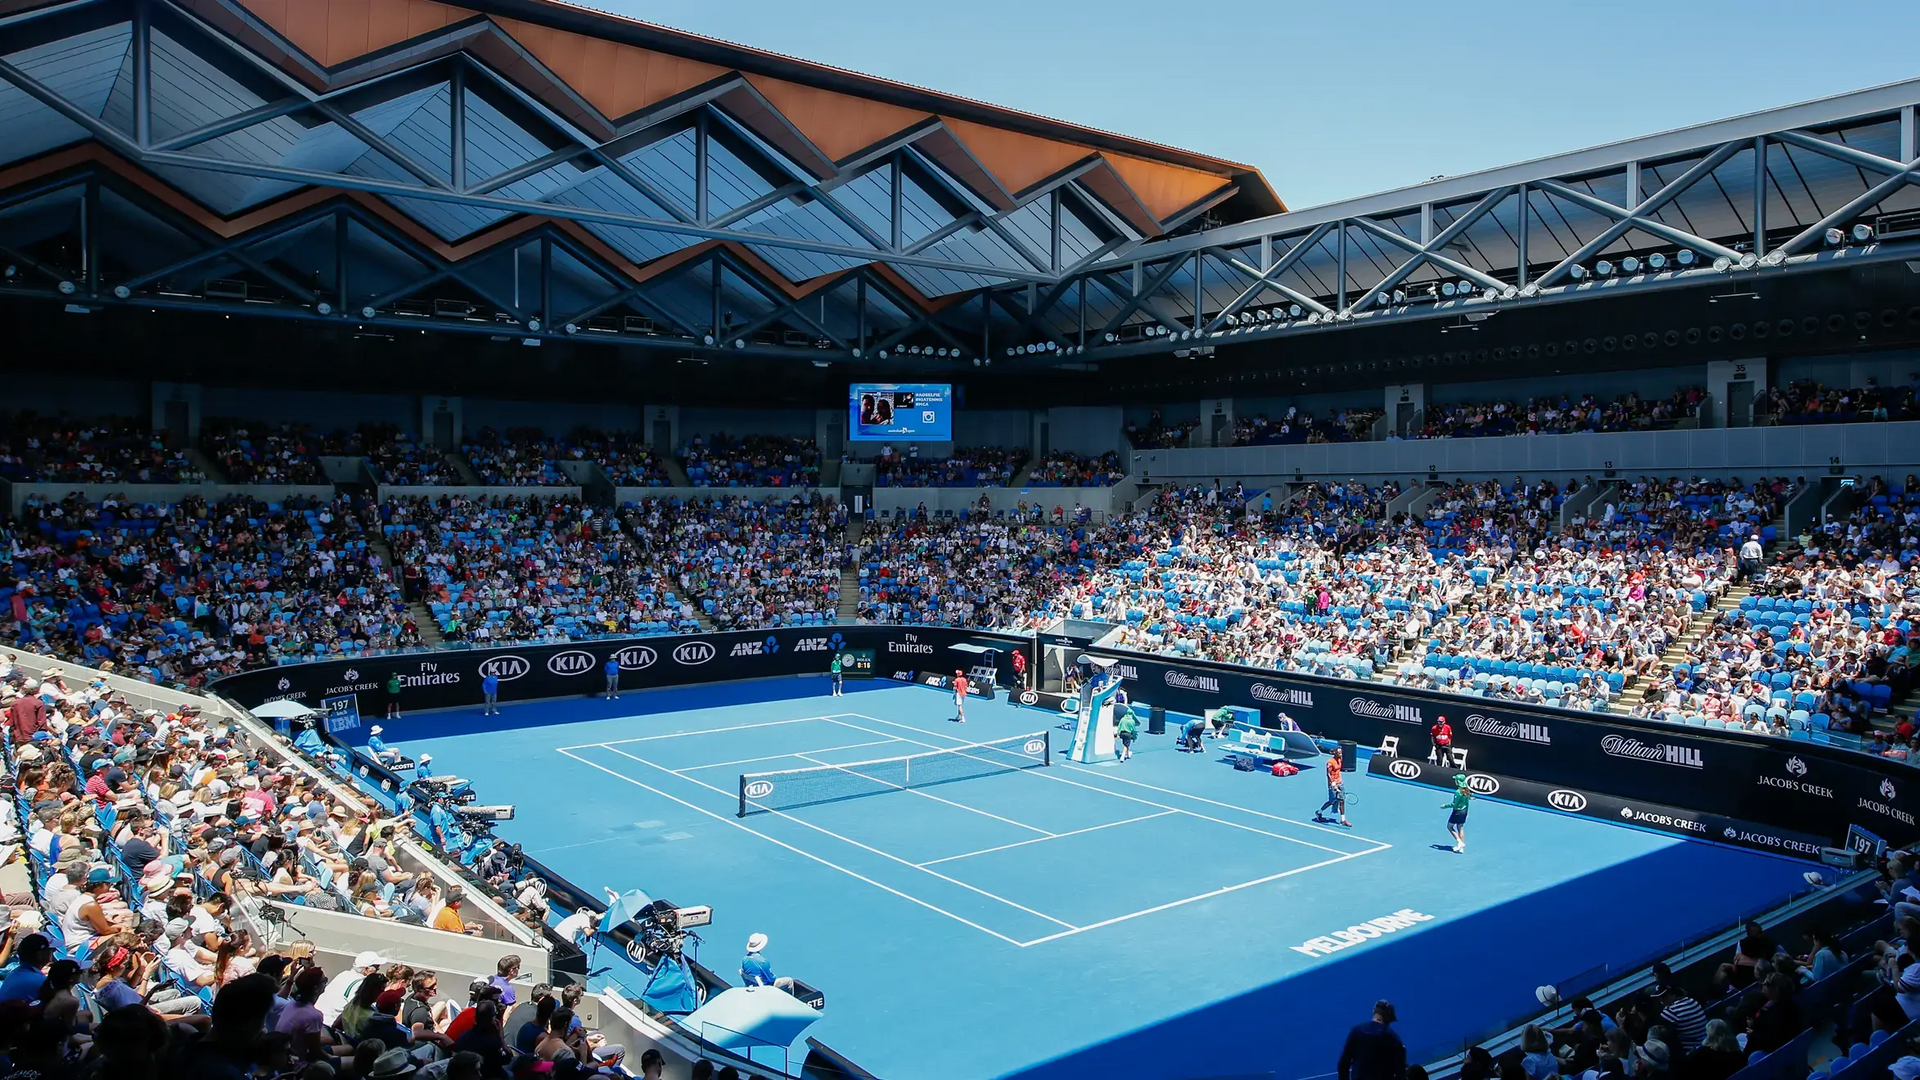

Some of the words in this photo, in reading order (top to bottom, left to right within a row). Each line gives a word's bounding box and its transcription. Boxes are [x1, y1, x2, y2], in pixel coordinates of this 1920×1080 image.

[1735, 364, 1745, 372] 35
[1829, 456, 1840, 464] 14
[794, 638, 828, 652] ANZ
[905, 633, 918, 643] Fly
[680, 646, 709, 661] KIA
[730, 641, 763, 657] ANZ
[888, 641, 934, 654] Emirates
[555, 655, 588, 671] KIA
[619, 650, 651, 666] KIA
[420, 662, 438, 673] Fly
[487, 660, 522, 676] KIA
[1120, 664, 1138, 679] HILL
[397, 672, 460, 688] Emirates
[925, 676, 941, 687] ANZ
[1164, 669, 1200, 689] William
[1199, 676, 1219, 691] HILL
[286, 691, 307, 700] CREEK
[325, 684, 354, 695] JACOB'S
[354, 682, 379, 692] CREEK
[1250, 682, 1290, 703] William
[1290, 689, 1314, 706] HILL
[331, 699, 350, 711] 197
[1022, 693, 1035, 703] KIA
[1349, 697, 1396, 718] William
[1395, 704, 1423, 723] HILL
[331, 716, 358, 732] IBM
[1465, 713, 1520, 738] William
[1519, 722, 1551, 743] HILL
[1028, 742, 1044, 752] KIA
[1600, 734, 1666, 761] William
[1665, 745, 1704, 767] HILL
[387, 762, 414, 771] ACOSTE
[1393, 763, 1416, 776] KIA
[749, 784, 770, 795] KIA
[1469, 776, 1494, 791] KIA
[1757, 775, 1799, 791] JACOB'S
[1801, 783, 1834, 799] CREEK
[1553, 793, 1581, 808] KIA
[1857, 797, 1890, 816] JACOB'S
[1891, 808, 1915, 826] CREEK
[1633, 811, 1673, 826] JACOB'S
[1673, 818, 1707, 833] CREEK
[1737, 831, 1781, 847] JACOB'S
[1783, 840, 1820, 855] CREEK
[1855, 835, 1872, 854] 197
[1289, 908, 1435, 958] MELBOURNE
